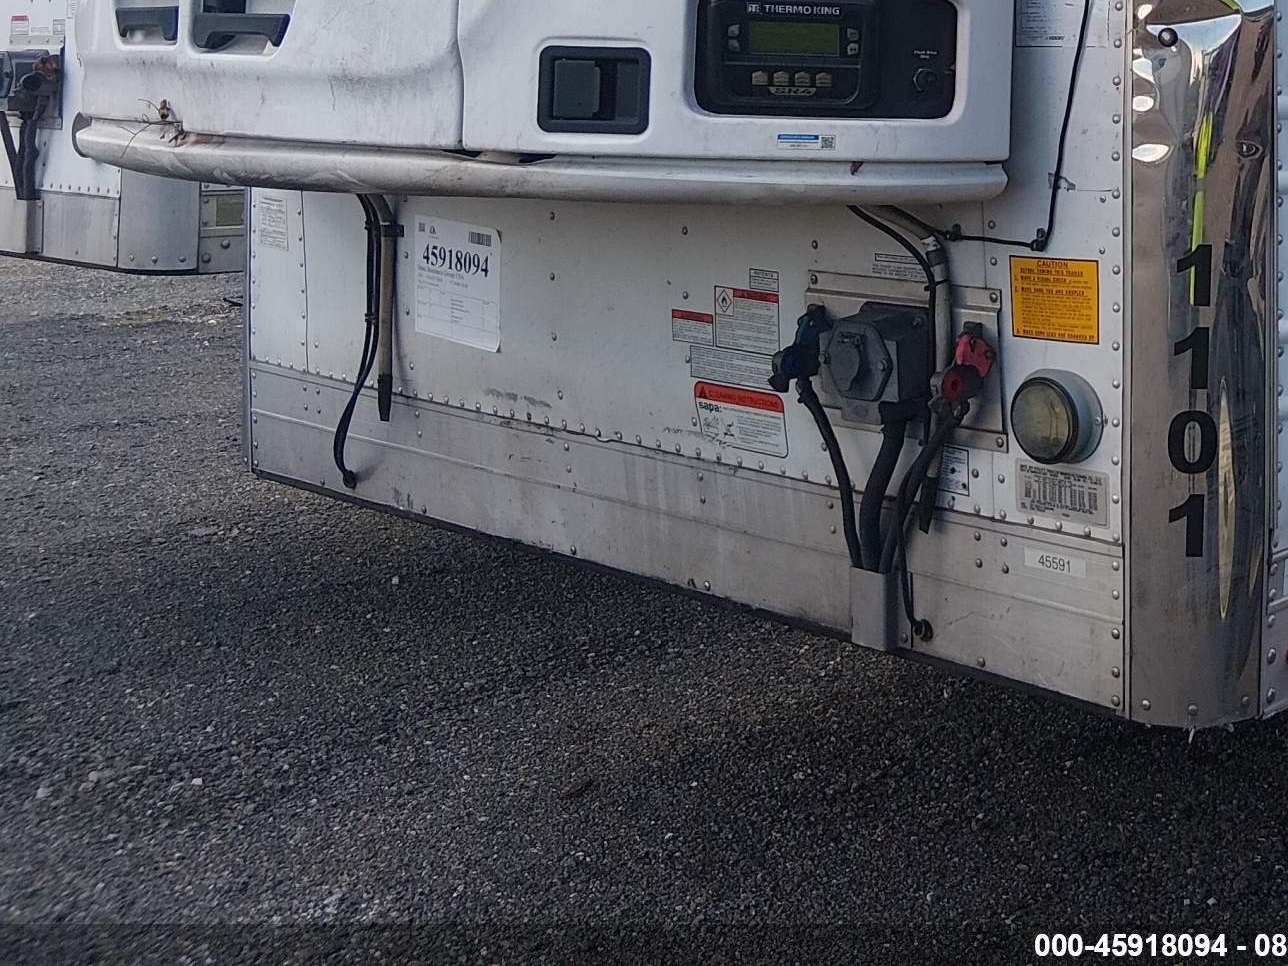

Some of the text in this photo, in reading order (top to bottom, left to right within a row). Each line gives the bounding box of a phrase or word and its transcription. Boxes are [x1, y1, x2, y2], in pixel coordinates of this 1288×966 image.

[763, 4, 812, 14] THERMO
[813, 6, 840, 15] KING
[423, 243, 489, 277] 45918094
[1037, 260, 1069, 268] CAUTION
[1038, 554, 1070, 573] 45591
